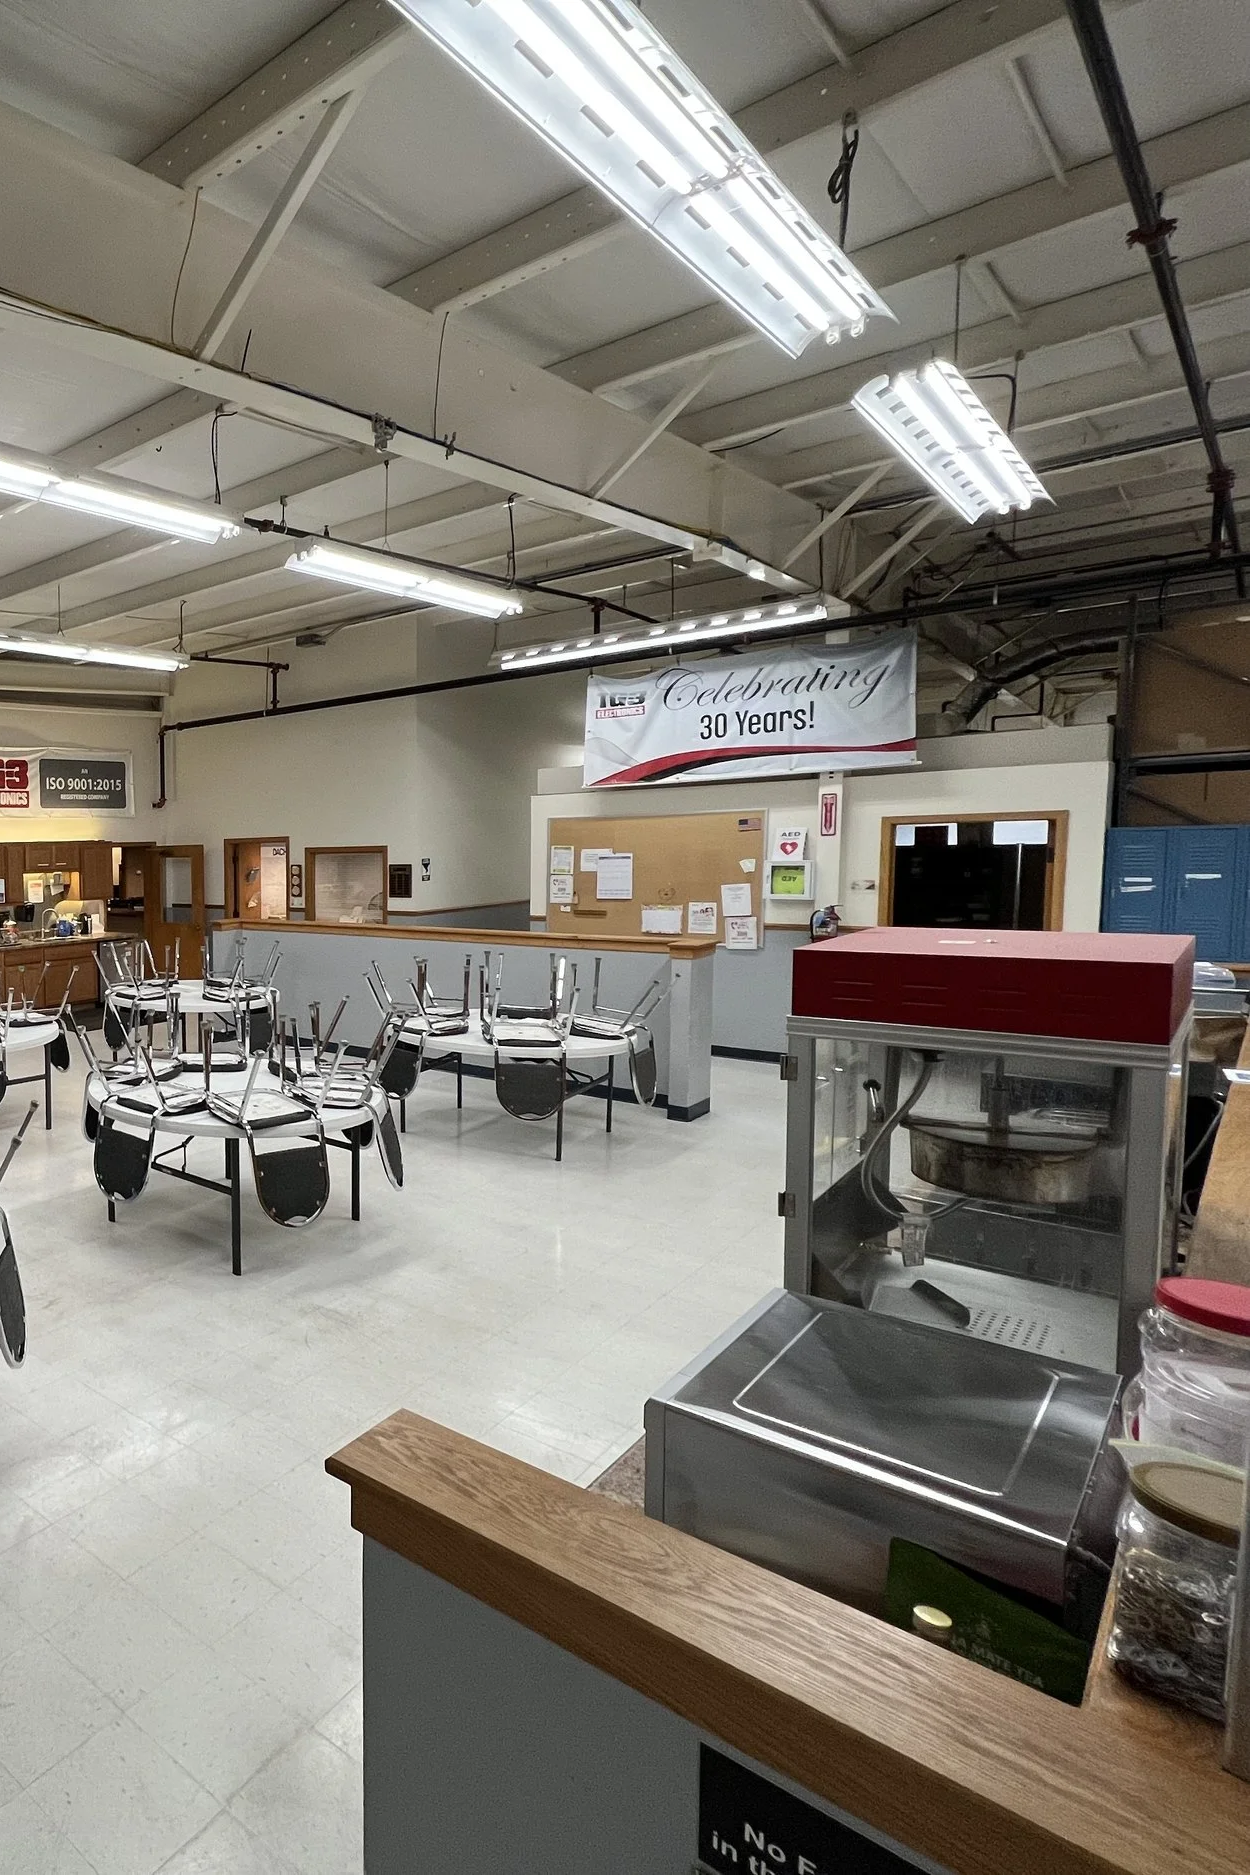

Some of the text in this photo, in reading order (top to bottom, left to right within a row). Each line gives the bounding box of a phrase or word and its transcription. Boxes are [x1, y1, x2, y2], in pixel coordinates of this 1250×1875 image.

[655, 664, 896, 711] Celebrating
[700, 701, 815, 741] 30 Years!
[46, 777, 122, 791] ISO 9001:2015
[712, 1830, 738, 1863] in
[744, 1822, 786, 1863] No
